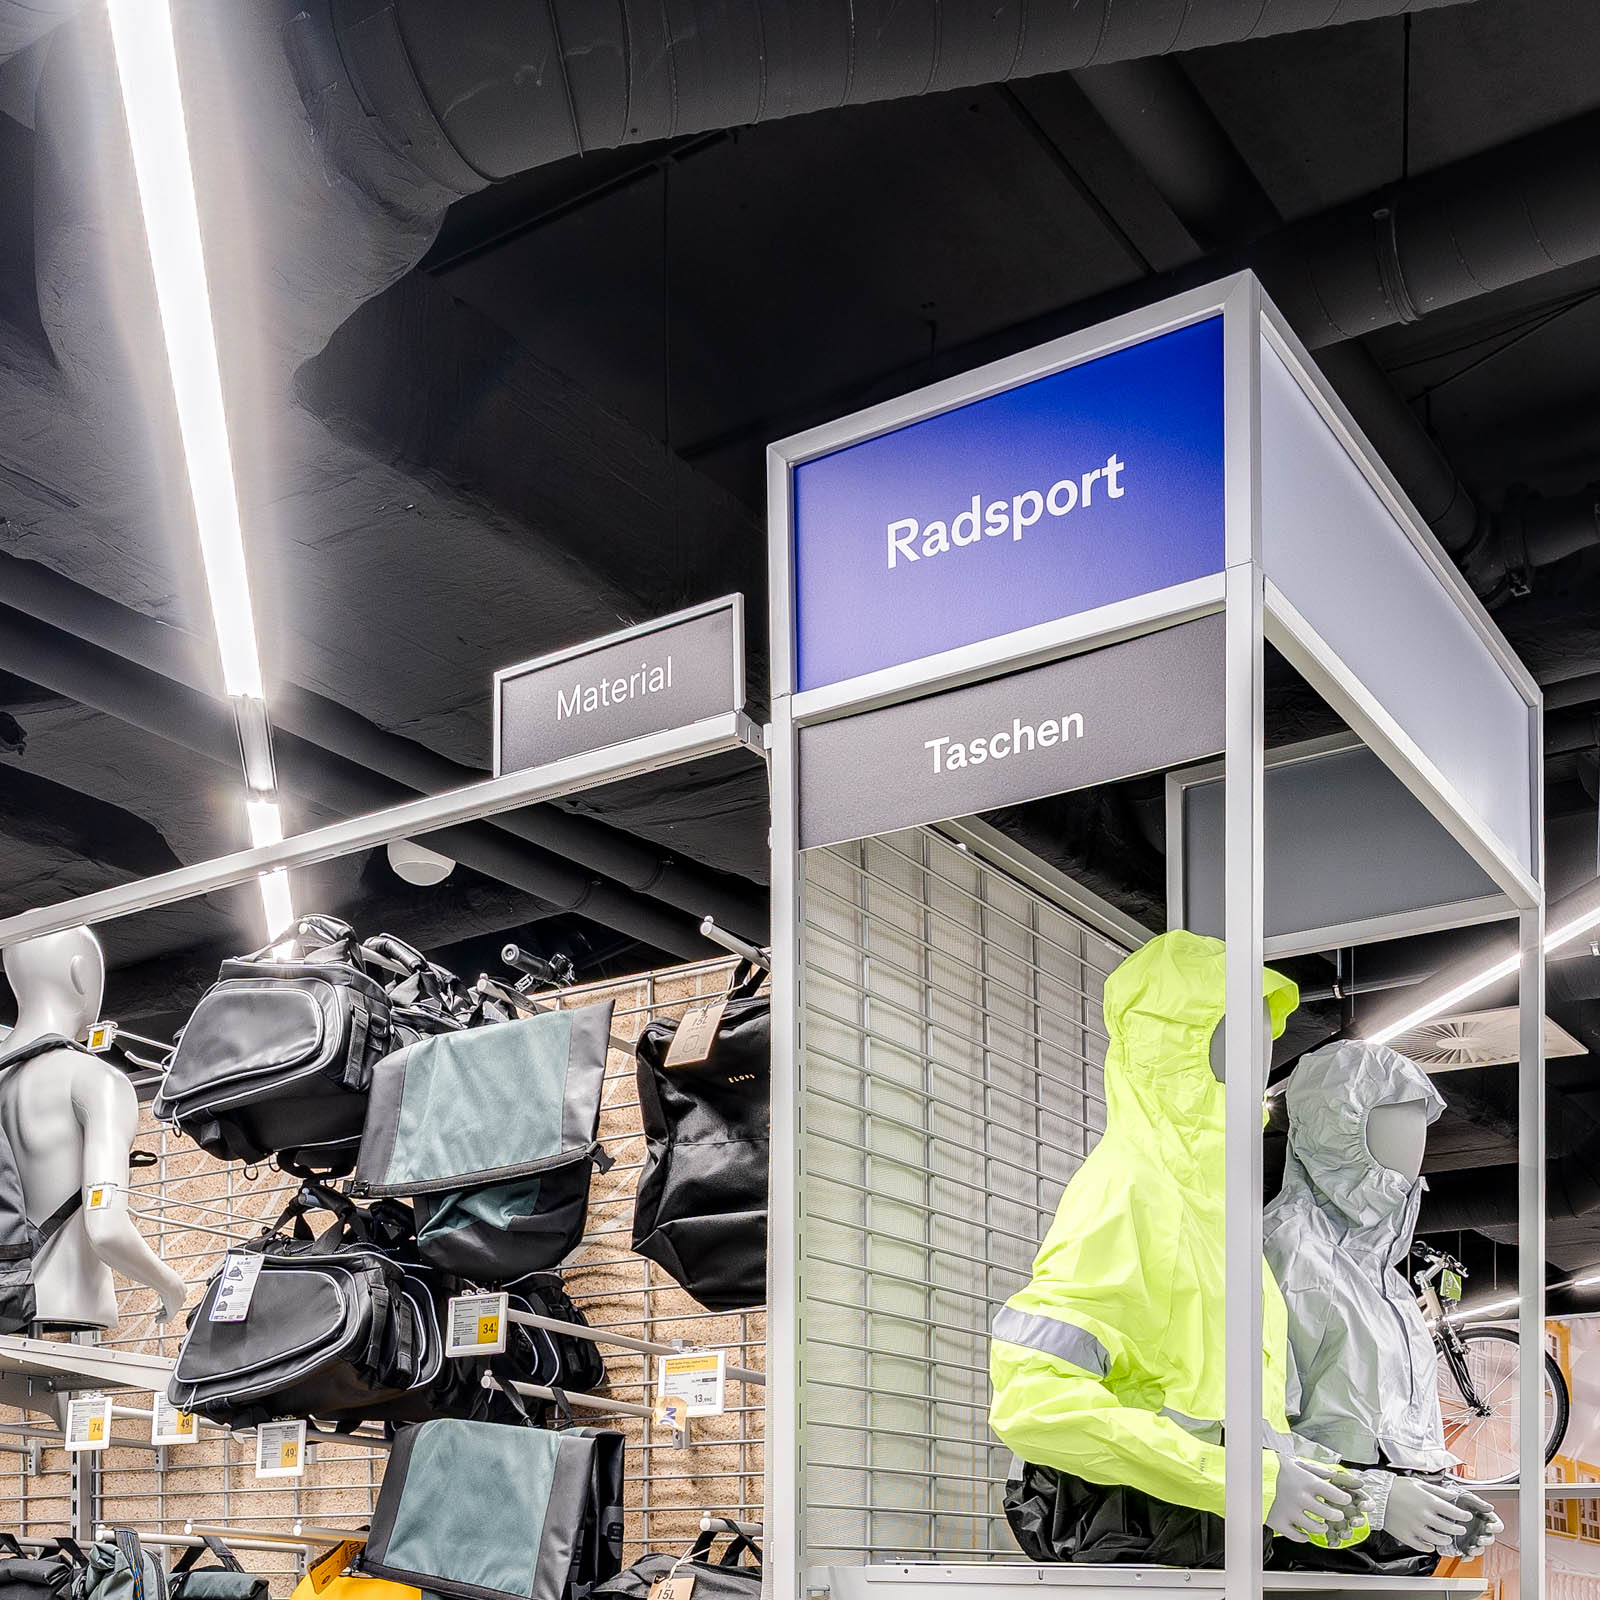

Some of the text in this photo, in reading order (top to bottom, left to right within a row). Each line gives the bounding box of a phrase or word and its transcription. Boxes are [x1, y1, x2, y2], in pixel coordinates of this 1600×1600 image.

[885, 452, 1126, 570] Radsport
[555, 656, 673, 721] Material
[924, 710, 1085, 776] Taschen
[656, 1589, 675, 1600] 15L
